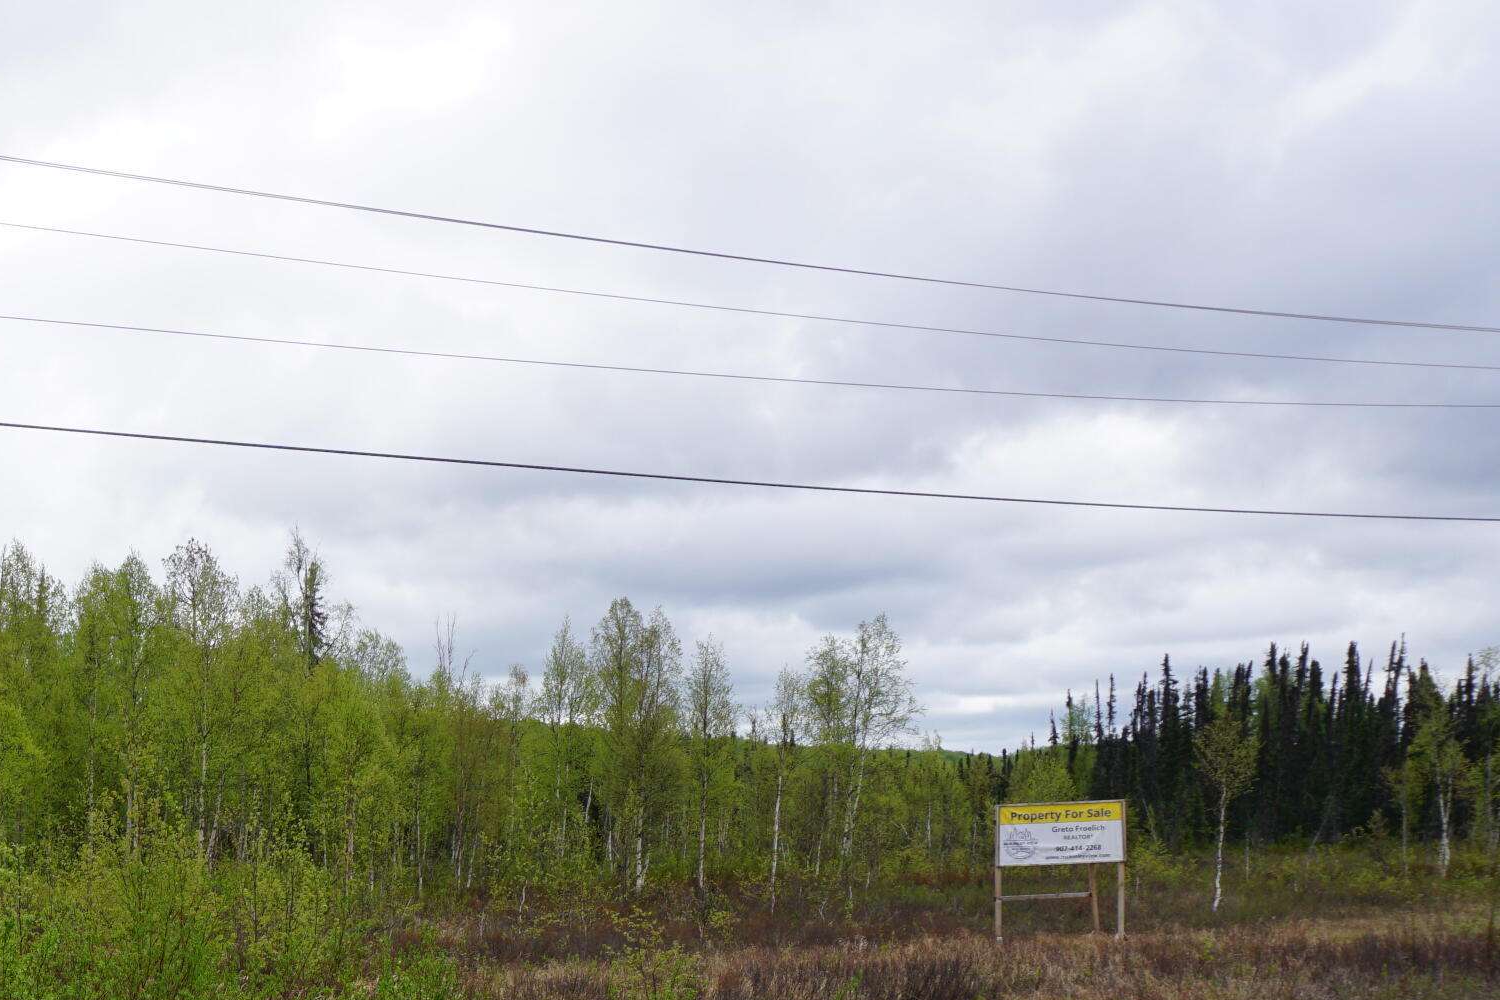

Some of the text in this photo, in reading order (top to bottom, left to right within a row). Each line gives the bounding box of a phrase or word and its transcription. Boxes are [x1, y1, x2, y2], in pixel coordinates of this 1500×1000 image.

[1011, 808, 1112, 822] Property For Sale
